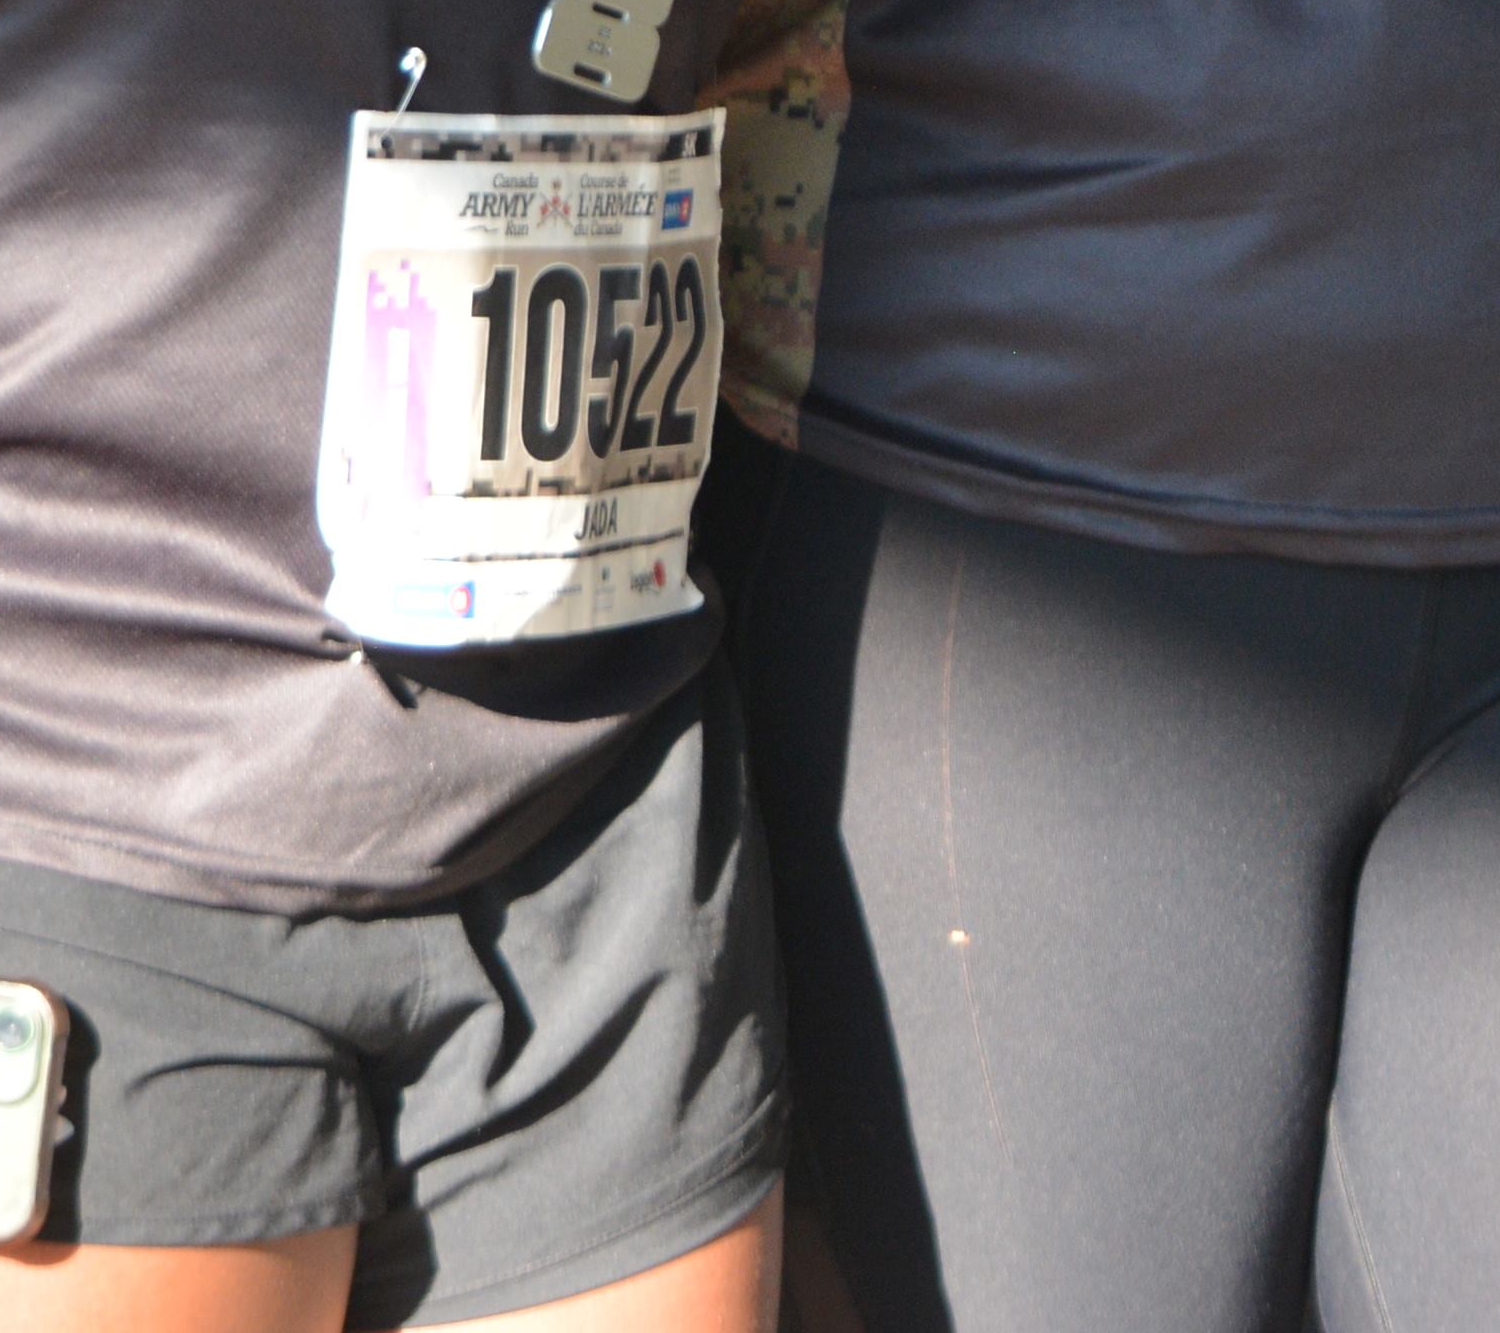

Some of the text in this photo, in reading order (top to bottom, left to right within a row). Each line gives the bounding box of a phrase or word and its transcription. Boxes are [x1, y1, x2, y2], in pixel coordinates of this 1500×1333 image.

[492, 171, 540, 189] Canada
[580, 171, 629, 189] Course de
[458, 191, 536, 217] ARMY
[576, 182, 658, 218] L'ARMÉE
[505, 220, 529, 237] Run
[471, 253, 705, 462] 10522
[575, 497, 618, 540] JADA
